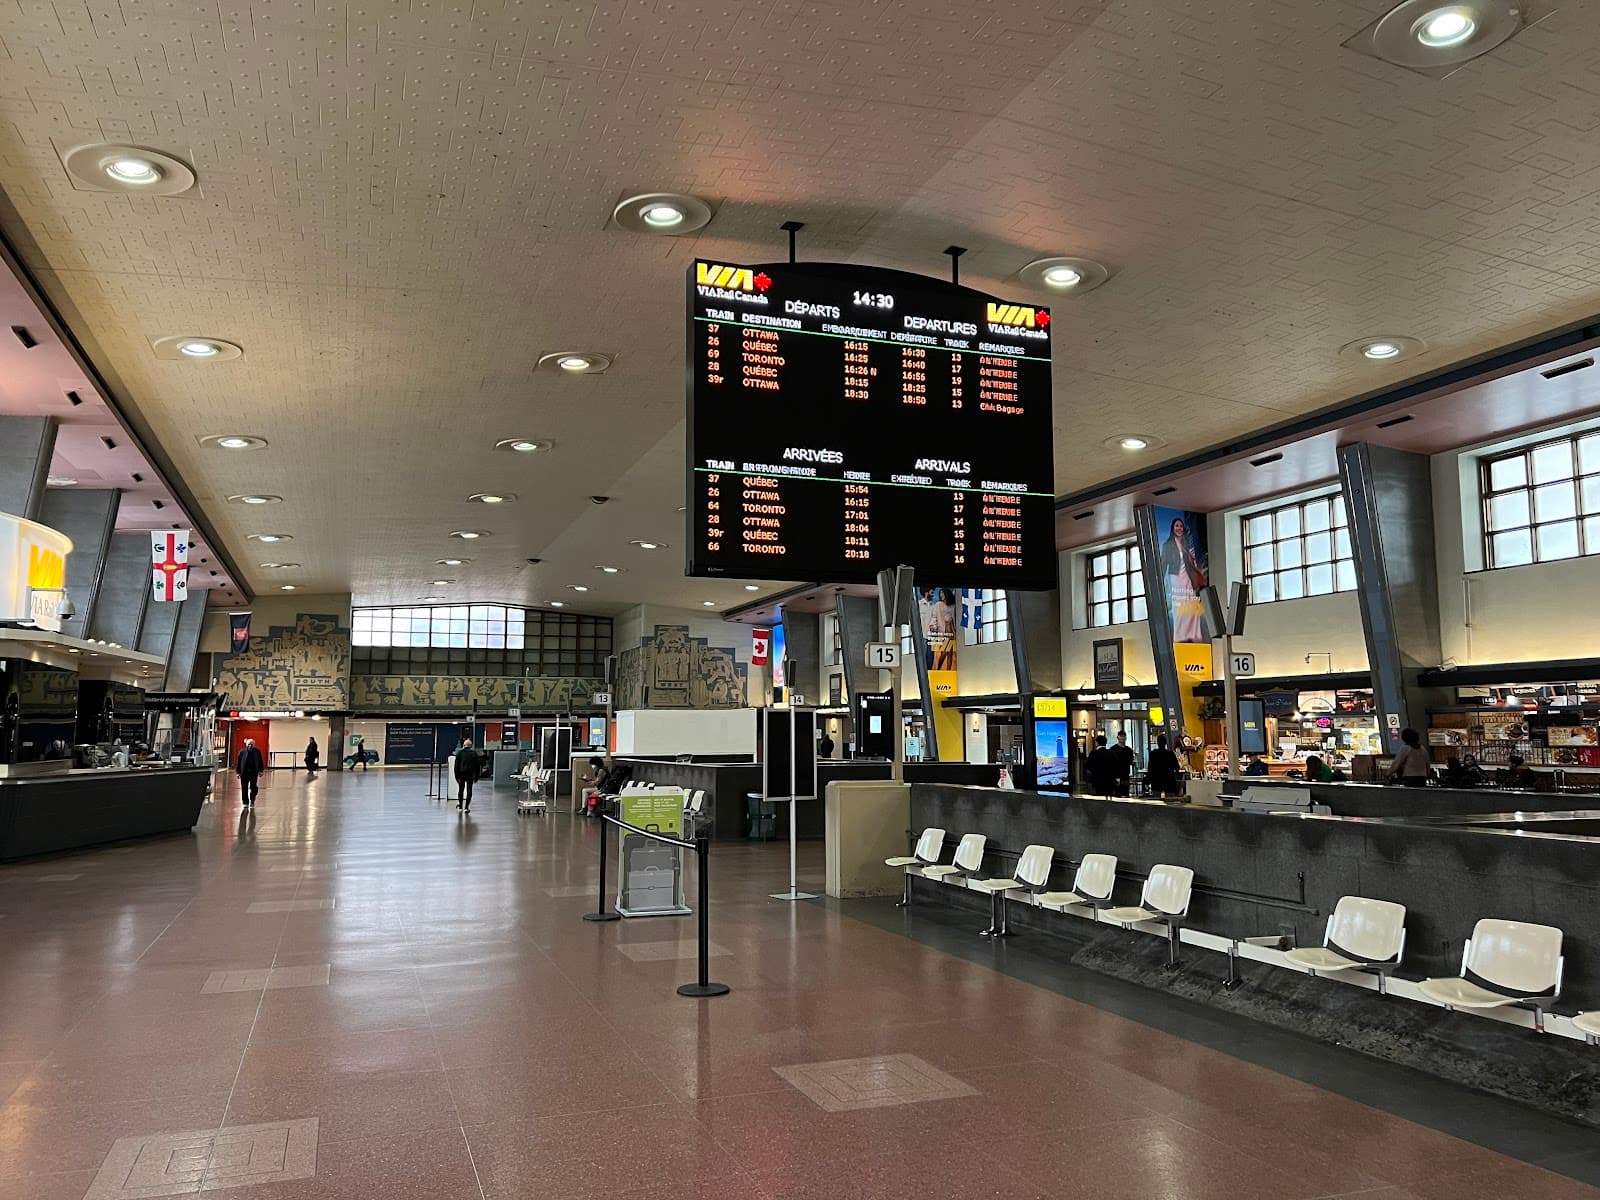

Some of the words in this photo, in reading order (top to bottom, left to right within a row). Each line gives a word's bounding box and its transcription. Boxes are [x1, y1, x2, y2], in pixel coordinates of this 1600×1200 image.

[697, 263, 753, 291] VIA
[735, 292, 769, 304] Canada
[853, 291, 894, 309] 14:30
[706, 308, 734, 320] TRAIN
[742, 313, 801, 329] DESTINATION
[785, 299, 840, 319] DÉPARTS
[987, 303, 1036, 328] VIA
[904, 316, 977, 335] DEPARTURES
[1020, 328, 1048, 339] Canada
[708, 324, 719, 333] 37
[743, 328, 779, 340] OTTAWA
[845, 341, 868, 351] 16:15
[903, 350, 926, 360] 16:30
[952, 353, 961, 362] 13
[708, 336, 719, 346] 26
[743, 339, 778, 353] QUÉBEC
[903, 360, 926, 369] 16:40
[952, 365, 961, 373] 17
[742, 353, 786, 366] TORONTO
[952, 377, 962, 385] 19
[743, 364, 778, 378] QUÉBEC
[952, 388, 962, 397] 15
[743, 378, 779, 390] OTTAWA
[952, 400, 962, 409] 13
[706, 460, 734, 470] TRAIN
[783, 447, 843, 464] ARRIVÉES
[915, 459, 971, 473] ARRIVALS
[708, 474, 719, 483] 37
[743, 476, 778, 488] QUÉBEC
[954, 493, 964, 501] 13
[708, 487, 719, 496] 26
[743, 490, 780, 501] OTTAWA
[954, 505, 964, 513] 17
[742, 503, 786, 515] TORONTO
[954, 518, 964, 526] 14
[743, 517, 780, 528] OTTAWA
[954, 530, 964, 539] 15
[743, 529, 778, 541] QUÉBEC
[955, 543, 965, 552] 13
[743, 544, 786, 555] TORONTO
[955, 556, 965, 565] 16
[876, 648, 894, 663] 15
[1234, 657, 1250, 671] 16
[599, 694, 608, 703] 13
